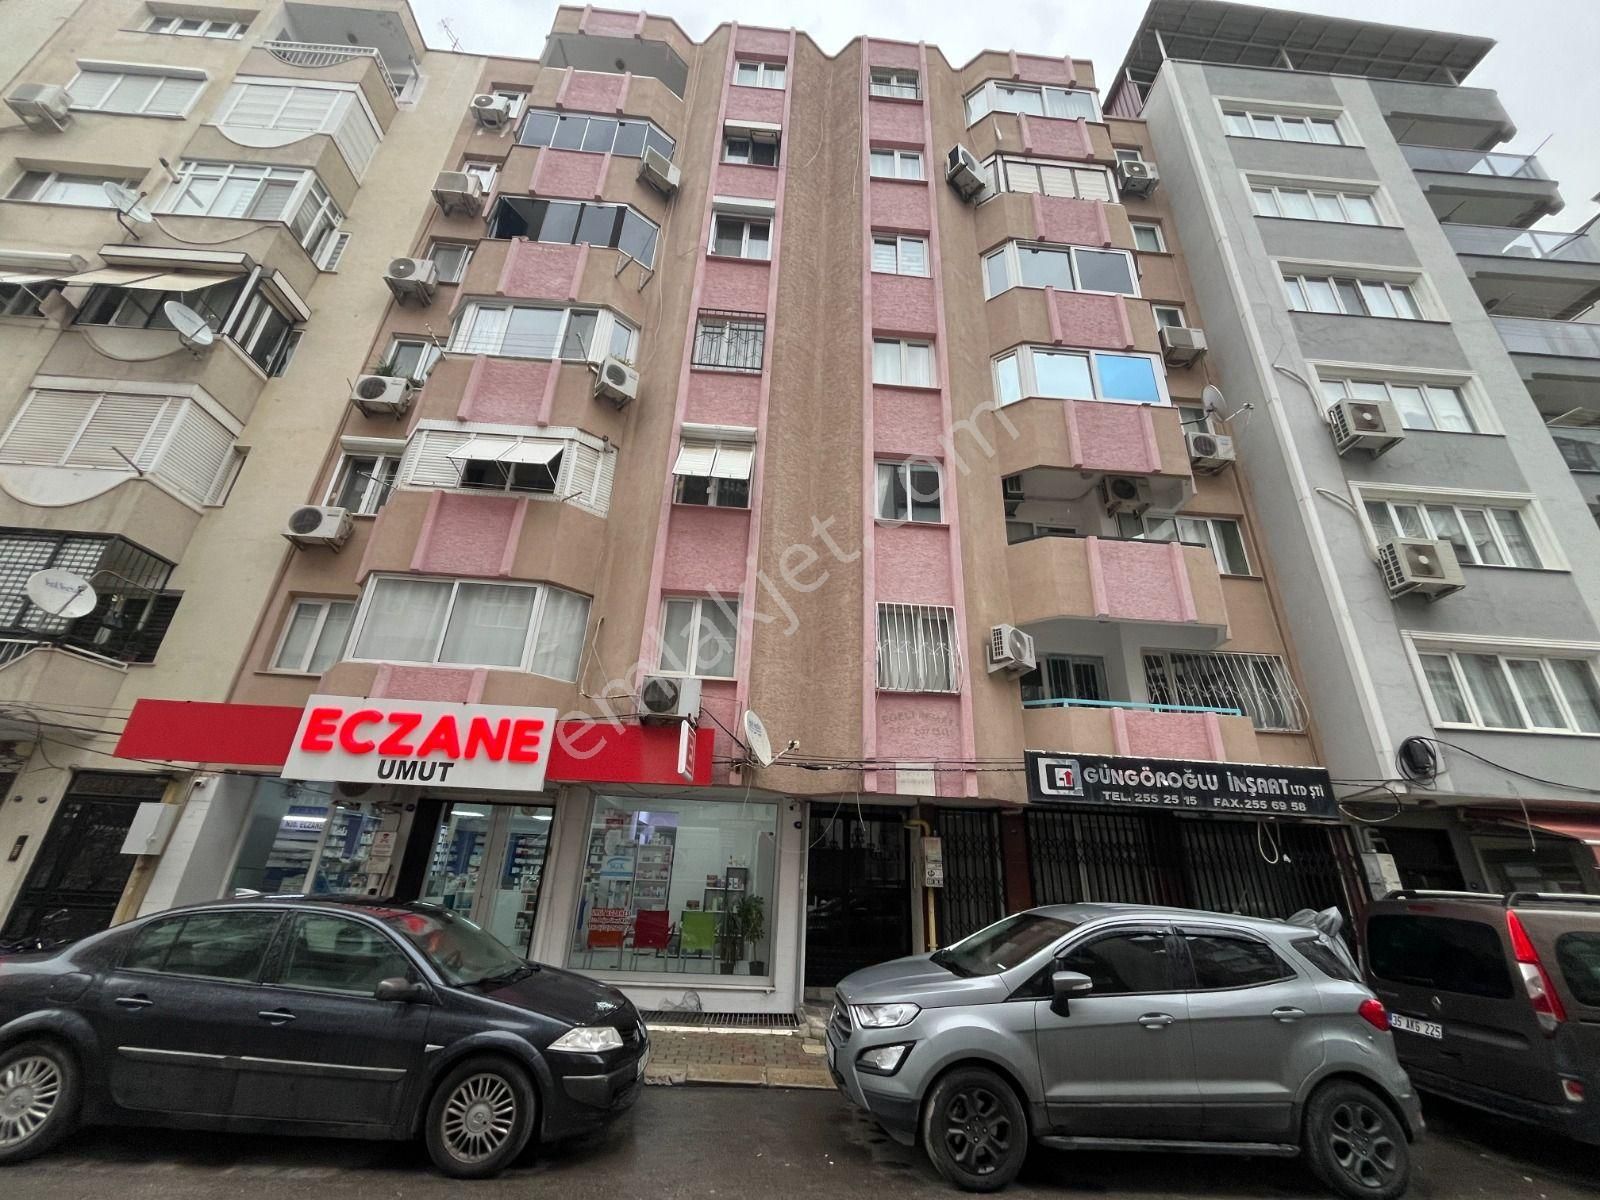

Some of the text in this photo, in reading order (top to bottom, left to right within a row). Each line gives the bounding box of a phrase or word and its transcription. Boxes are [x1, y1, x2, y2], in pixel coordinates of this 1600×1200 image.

[300, 707, 545, 763] ECZANE
[377, 759, 455, 782] UMUT
[1083, 764, 1219, 791] GÜNGÖROĞLU
[1226, 771, 1289, 797] İNŞAAT
[1290, 786, 1308, 796] LTD
[1102, 791, 1132, 802] TEL.
[1134, 793, 1159, 804] 255
[1163, 794, 1180, 804] 25
[1183, 795, 1198, 806] 15
[1271, 801, 1287, 811] 69
[1290, 801, 1307, 812] 58
[1392, 1015, 1402, 1026] 35
[1424, 1022, 1441, 1038] 225
